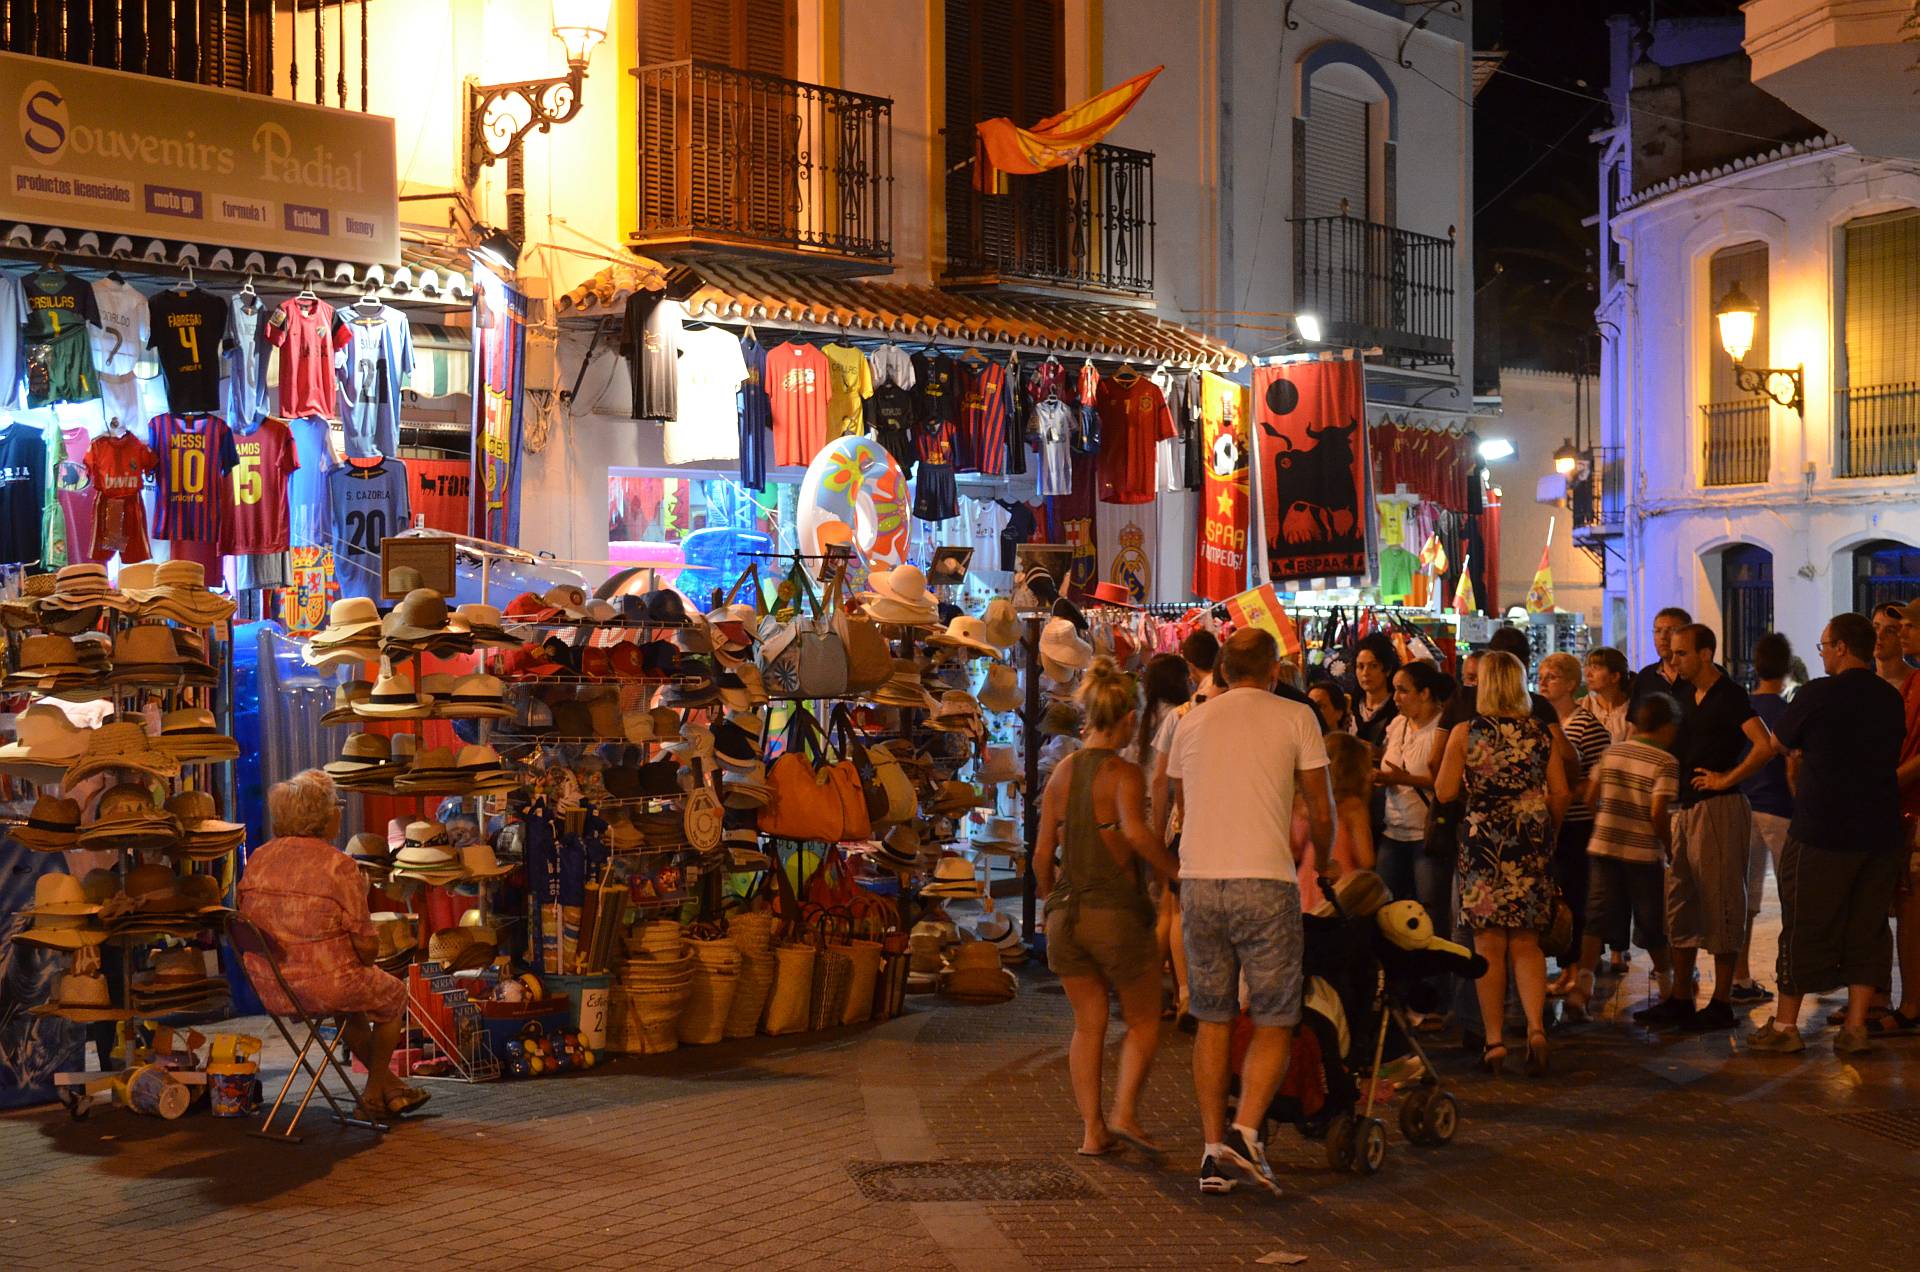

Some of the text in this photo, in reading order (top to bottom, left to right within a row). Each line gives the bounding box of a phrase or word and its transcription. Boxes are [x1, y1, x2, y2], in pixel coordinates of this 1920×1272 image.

[25, 91, 365, 192] Souvenirs Padial
[17, 174, 130, 202] productos licenciados
[153, 192, 194, 213] moto gp
[223, 201, 267, 221] formula 1
[293, 210, 321, 229] futbol
[346, 217, 375, 238] Disney
[105, 326, 123, 366] 7
[179, 326, 199, 364] 4
[171, 434, 206, 449] MESSI
[235, 442, 260, 456] AMOS
[105, 473, 138, 489] bwin
[171, 448, 205, 493] 10
[232, 455, 262, 506] 15
[356, 490, 391, 500] CAZORLA
[346, 509, 387, 555] 20
[594, 1011, 603, 1033] 2
